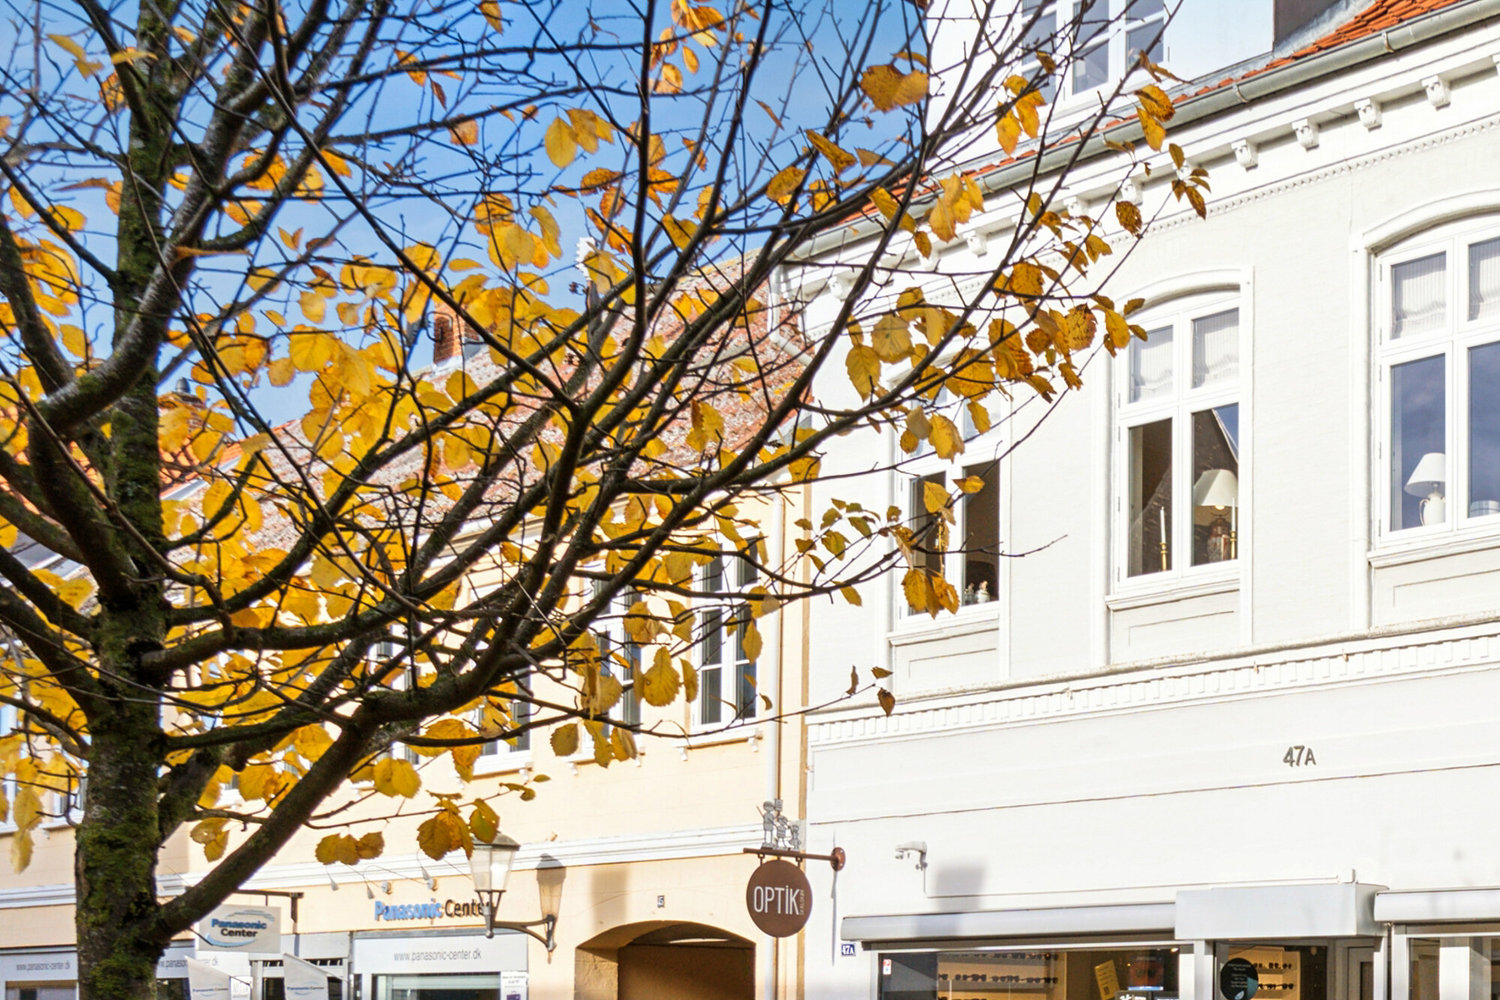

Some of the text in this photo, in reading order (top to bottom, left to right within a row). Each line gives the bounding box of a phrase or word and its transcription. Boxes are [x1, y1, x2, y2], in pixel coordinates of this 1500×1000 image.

[1282, 744, 1317, 768] 47A
[374, 898, 443, 922] Panasonic
[211, 918, 268, 930] Panasonic
[220, 927, 259, 938] Center
[394, 948, 482, 962] www.panasonic-center.dk
